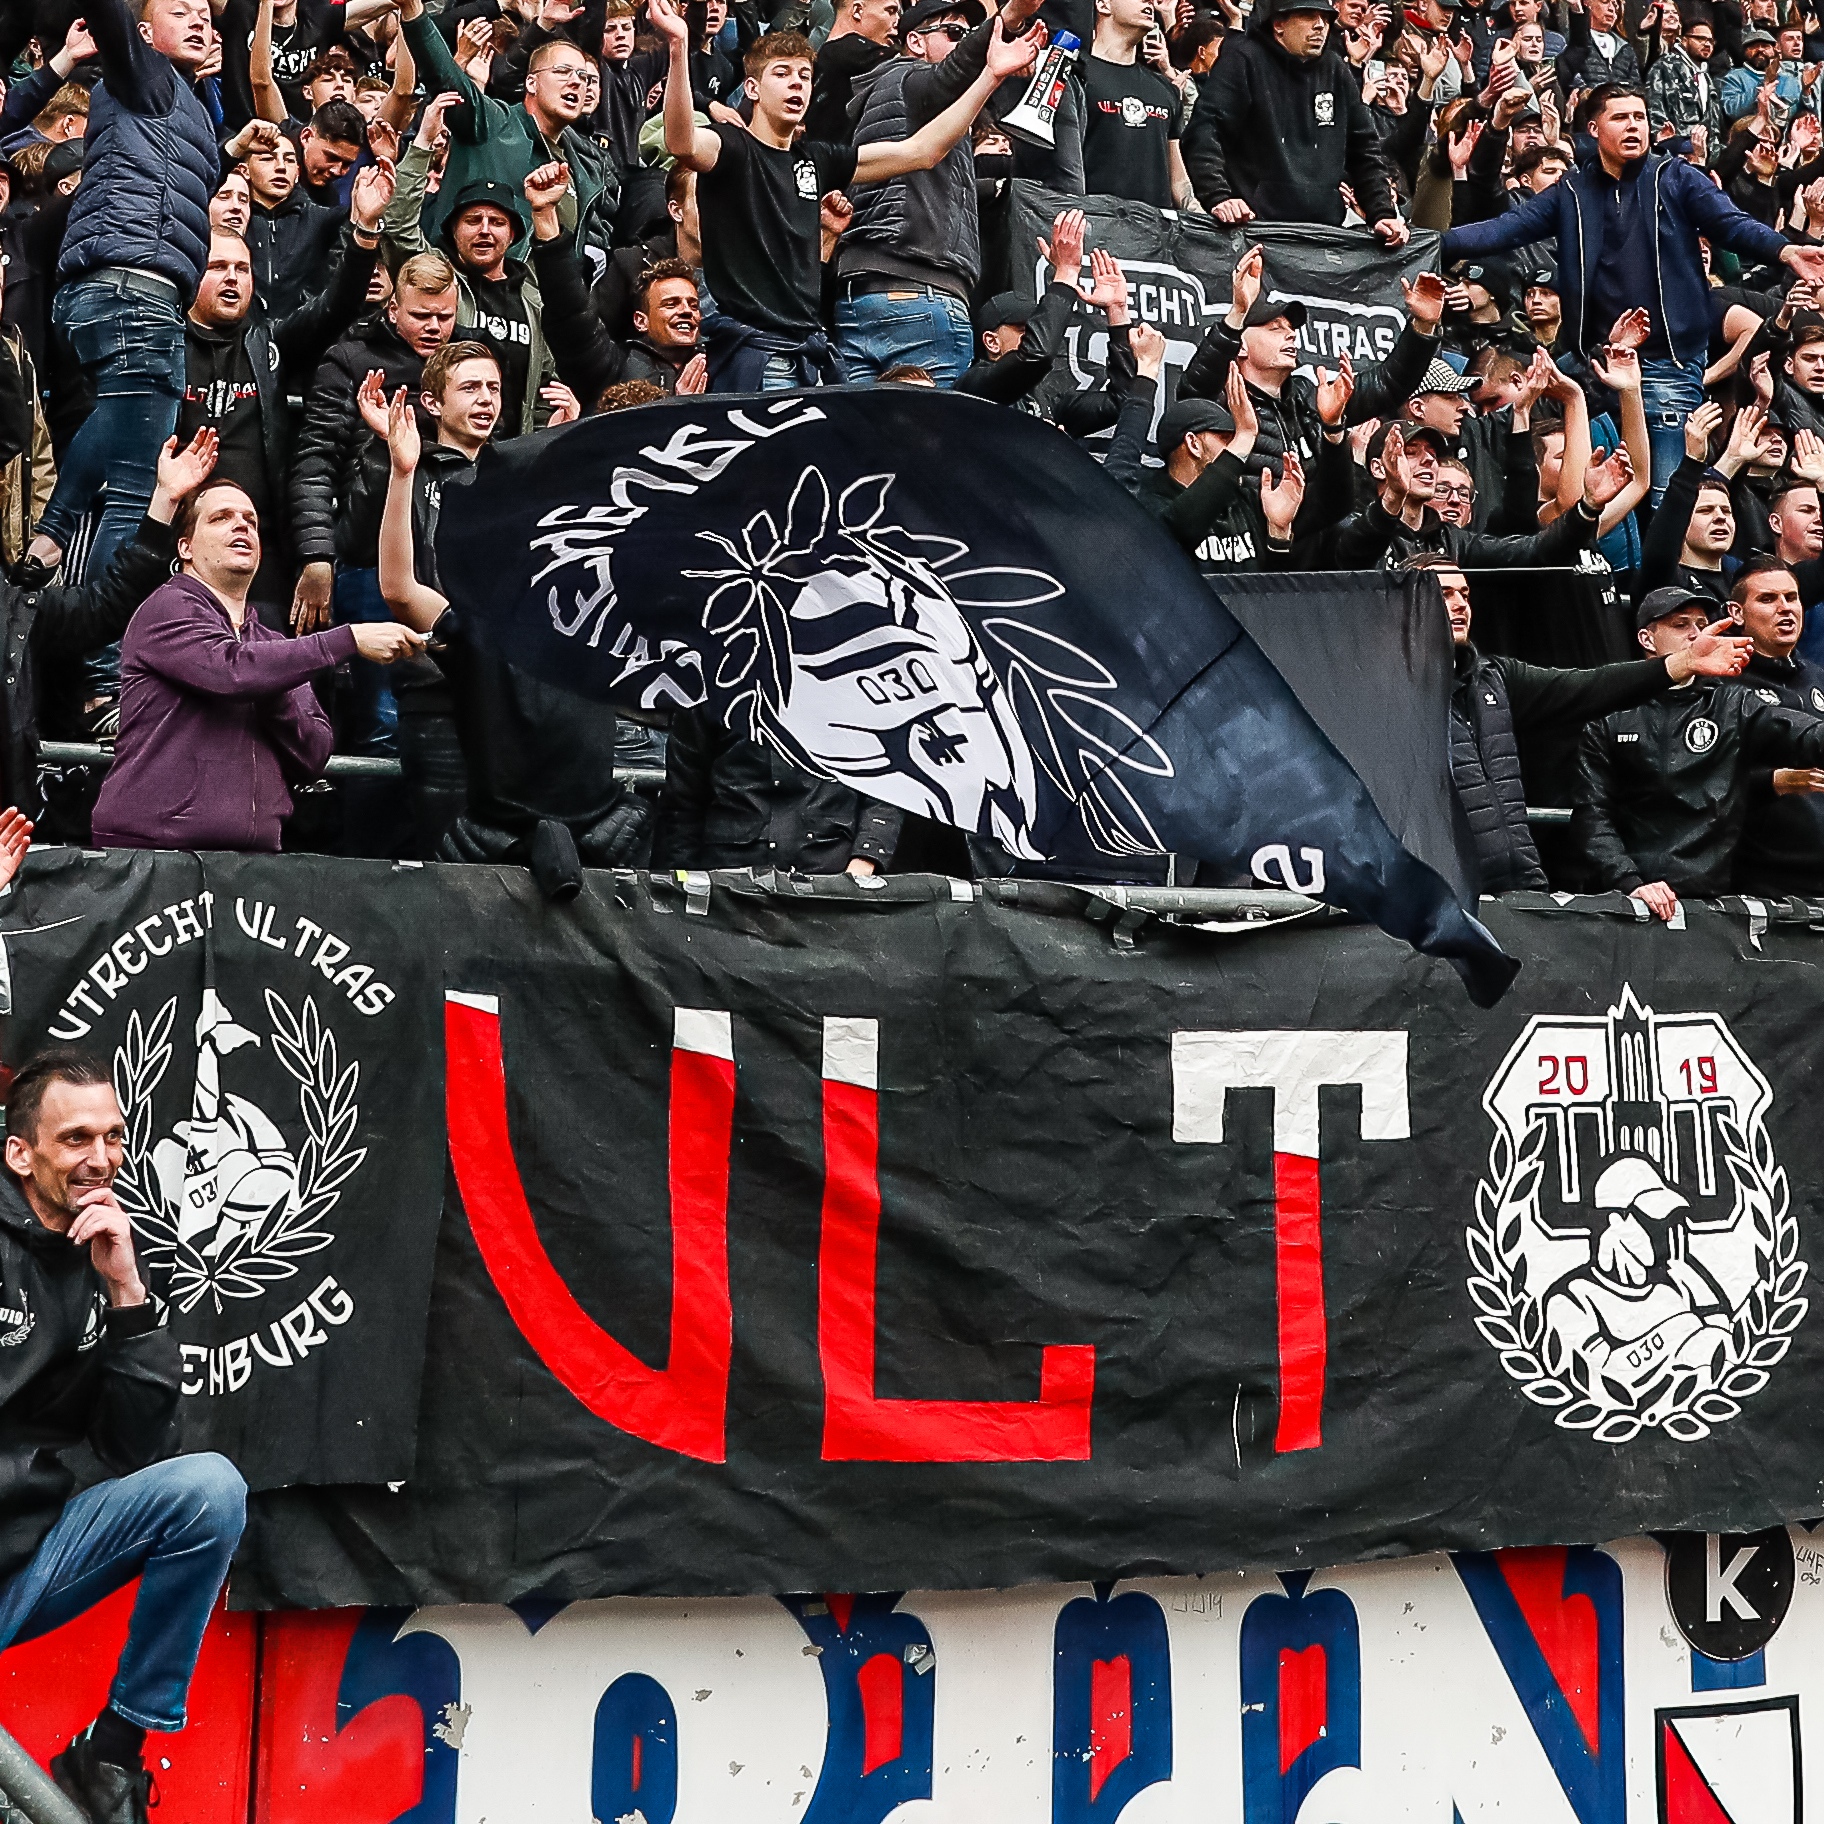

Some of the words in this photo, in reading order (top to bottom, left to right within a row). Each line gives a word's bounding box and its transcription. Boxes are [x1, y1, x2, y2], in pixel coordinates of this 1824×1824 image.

[1073, 278, 1199, 327] TECHT.
[856, 657, 939, 704] 030
[48, 890, 213, 1040] UTRECHT
[234, 897, 396, 1015] ULTRAS
[1539, 1056, 1589, 1095] 20
[1680, 1056, 1718, 1095] 19
[188, 1176, 218, 1209] 03
[1627, 1332, 1664, 1368] 030
[1705, 1534, 1762, 1622] K
